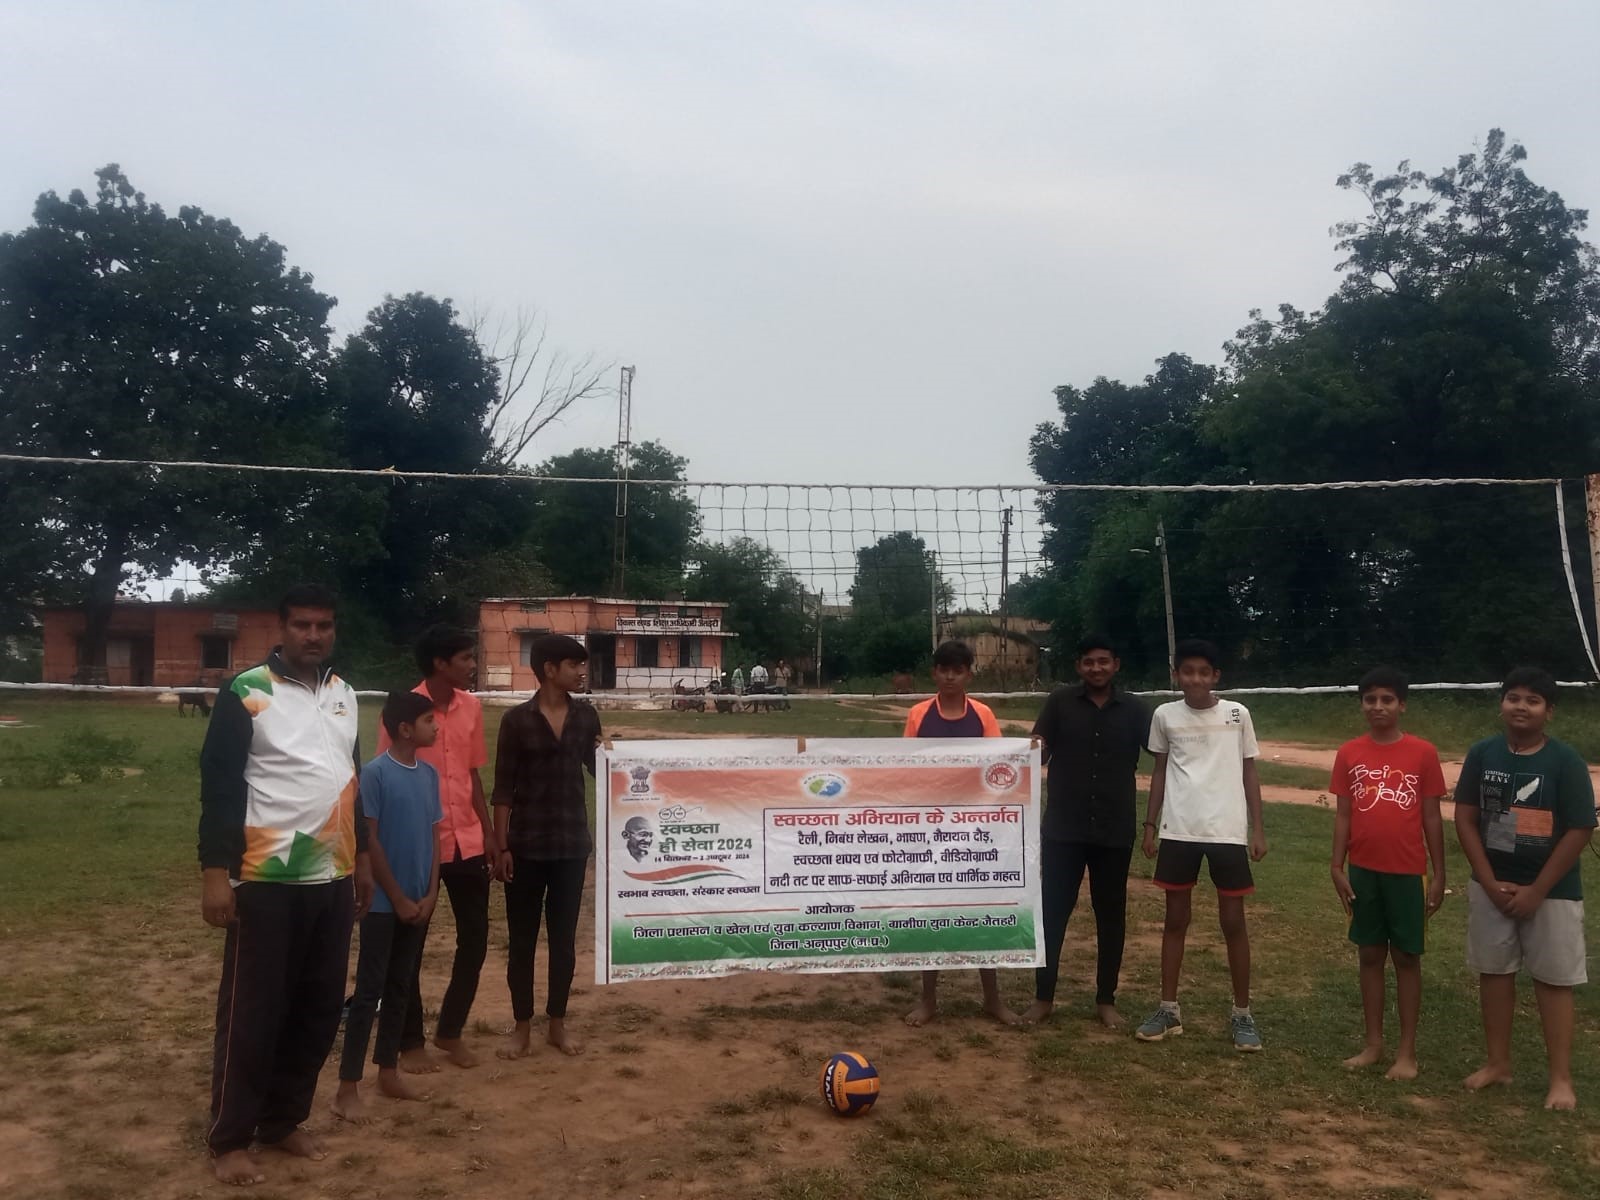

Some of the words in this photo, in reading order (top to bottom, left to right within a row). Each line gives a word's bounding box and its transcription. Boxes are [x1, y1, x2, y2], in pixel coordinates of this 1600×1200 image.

[1348, 764, 1419, 803] Being
[773, 813, 840, 826] स्वच्छता
[845, 809, 920, 825] अभियान
[925, 808, 945, 824] के
[950, 807, 1019, 823] अन्तर्गत
[660, 823, 720, 836] स्वच्छता
[659, 837, 677, 853] ही
[682, 837, 713, 851] सेवा
[717, 838, 752, 850] 2024
[798, 830, 822, 846] रैली,
[825, 830, 854, 844] निबंध
[857, 830, 893, 845] लेखन,
[896, 831, 930, 844] भाषण,
[793, 854, 832, 865] स्वच्छता
[835, 853, 861, 864] शपथ
[769, 873, 790, 887] नदी
[793, 875, 809, 886] तट
[811, 875, 825, 885] पर
[828, 870, 888, 886] साफ-सफाई
[891, 870, 935, 884] अभियान
[956, 868, 990, 882] धार्मिक
[993, 870, 1020, 882] महत्व
[618, 889, 648, 899] स्वभाव
[692, 885, 724, 896] संस्कार
[727, 886, 760, 895] स्वच्छता
[805, 902, 855, 914] आयोजक
[633, 926, 663, 939] जिला
[667, 924, 710, 937] प्रशासन
[714, 926, 722, 935] व
[726, 923, 750, 935] खेल
[754, 922, 769, 934] एवं
[773, 922, 794, 936] युवा
[798, 921, 841, 932] कल्याण
[844, 919, 885, 930] विभाग,
[888, 917, 926, 929] ग्रामीण
[930, 918, 950, 931] युवा
[954, 915, 979, 928] केन्द्र
[982, 914, 1017, 927] जैतहरी
[770, 938, 799, 950] जिला
[803, 937, 848, 949] अनूपपुर
